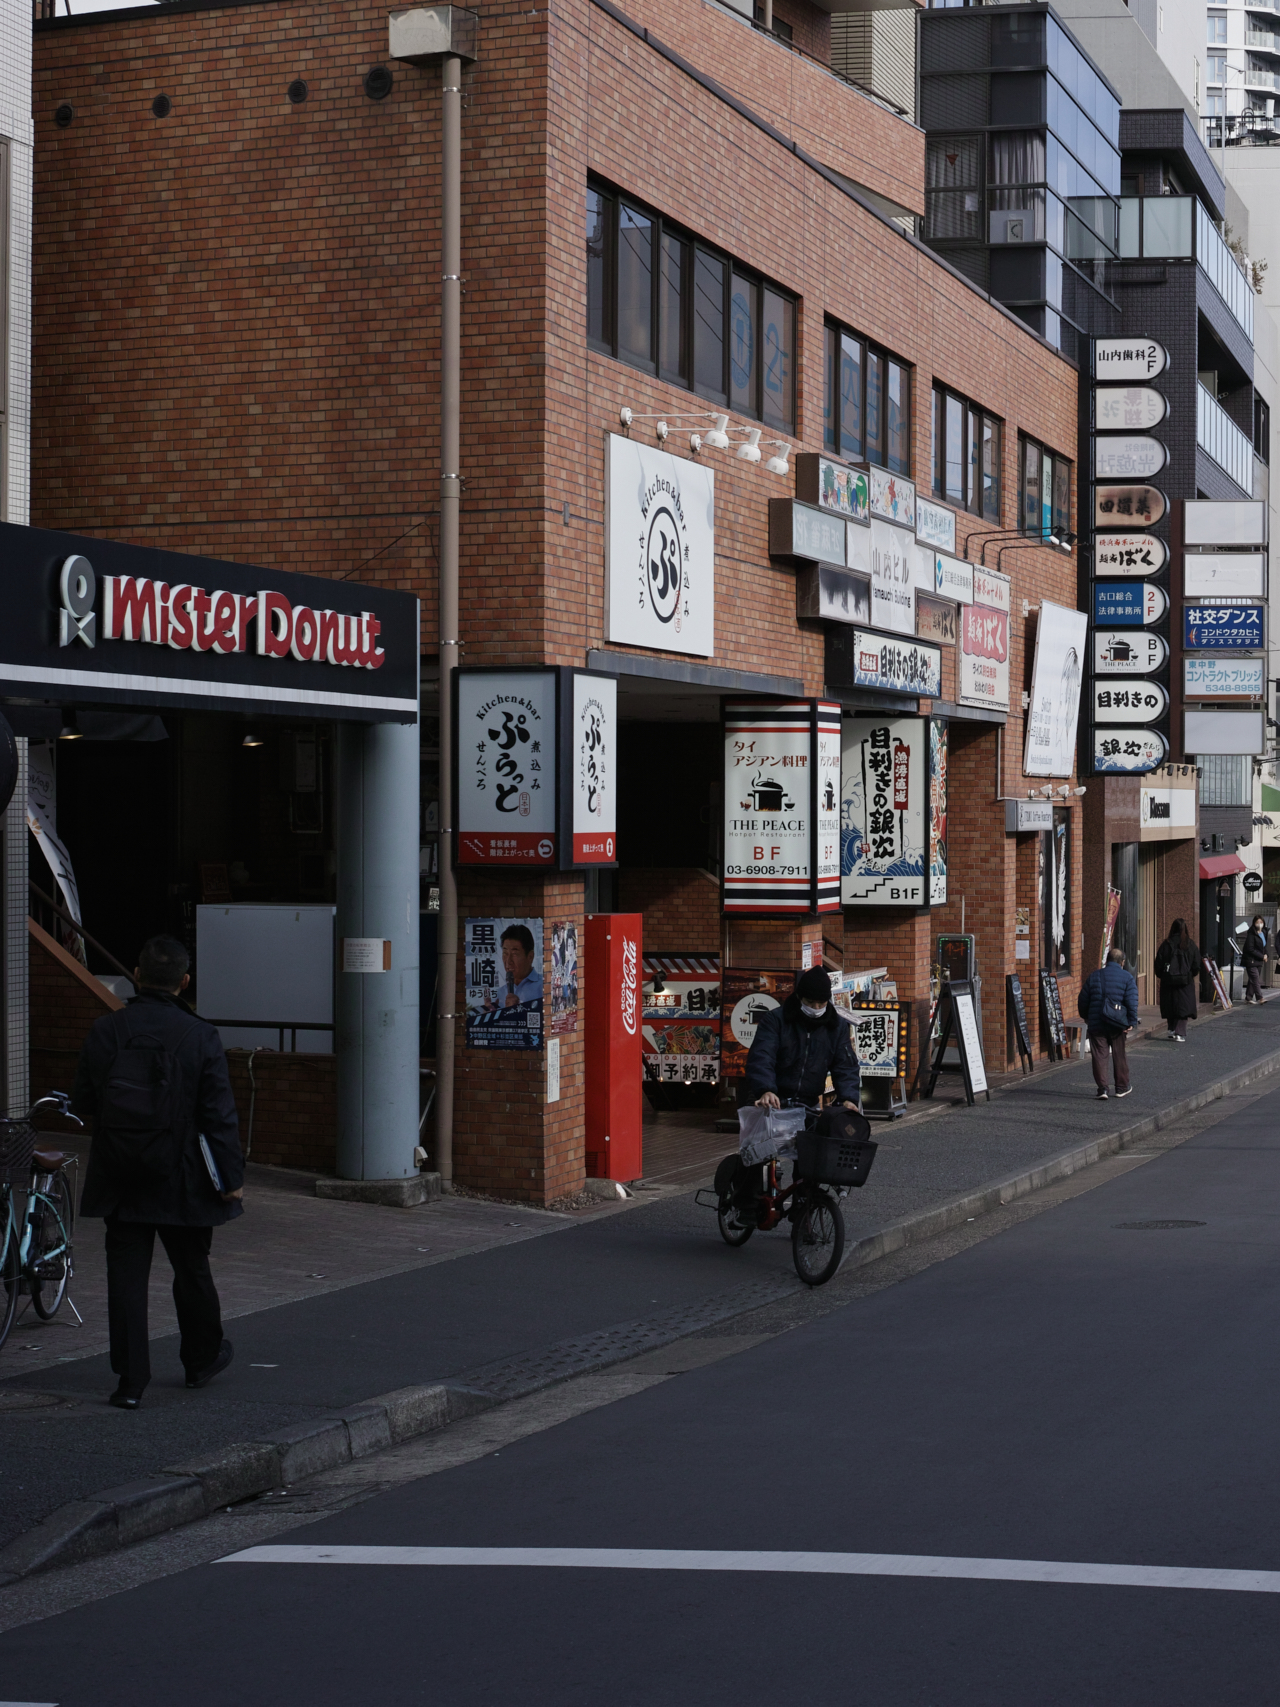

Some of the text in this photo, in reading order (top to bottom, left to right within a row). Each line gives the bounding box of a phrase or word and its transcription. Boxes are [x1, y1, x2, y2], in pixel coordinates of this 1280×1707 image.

[1099, 350, 1146, 362] 山内歯科
[872, 547, 909, 584] 山内ビル
[1098, 606, 1142, 616] 法律事務所
[1188, 609, 1260, 624] 社交ダンス
[102, 574, 386, 670] Mister Donut
[1201, 628, 1260, 636] コンドウタカヒト
[881, 645, 928, 687] 目利きの銀次
[1188, 660, 1217, 669] 東中野
[1186, 669, 1261, 682] コントラクトブリッジ
[1205, 684, 1260, 692] 5348-8955
[476, 694, 542, 721] Kitchen&bar
[1097, 691, 1159, 708] 目利きの
[733, 741, 757, 753] タイ
[1100, 738, 1142, 757] 銀次
[475, 740, 487, 790] せんべろ
[488, 711, 531, 813] ぷらっと
[530, 740, 542, 790] 煮込み
[585, 714, 601, 813] ぷらっと
[733, 755, 808, 768] アジアン料理
[895, 751, 908, 803] 漁港直送
[869, 727, 895, 859] 目利きの銀次
[730, 819, 806, 831] THE PEACE
[490, 839, 517, 849] 看板裏側
[490, 848, 535, 858] 階段上がって奥
[727, 865, 808, 875] 03-6908-7911
[890, 888, 920, 899] B1F
[470, 924, 498, 988] 黒崎
[622, 935, 637, 1035] Coca-Cola
[469, 989, 499, 999] ゆういち
[869, 1017, 886, 1061] 目利きの
